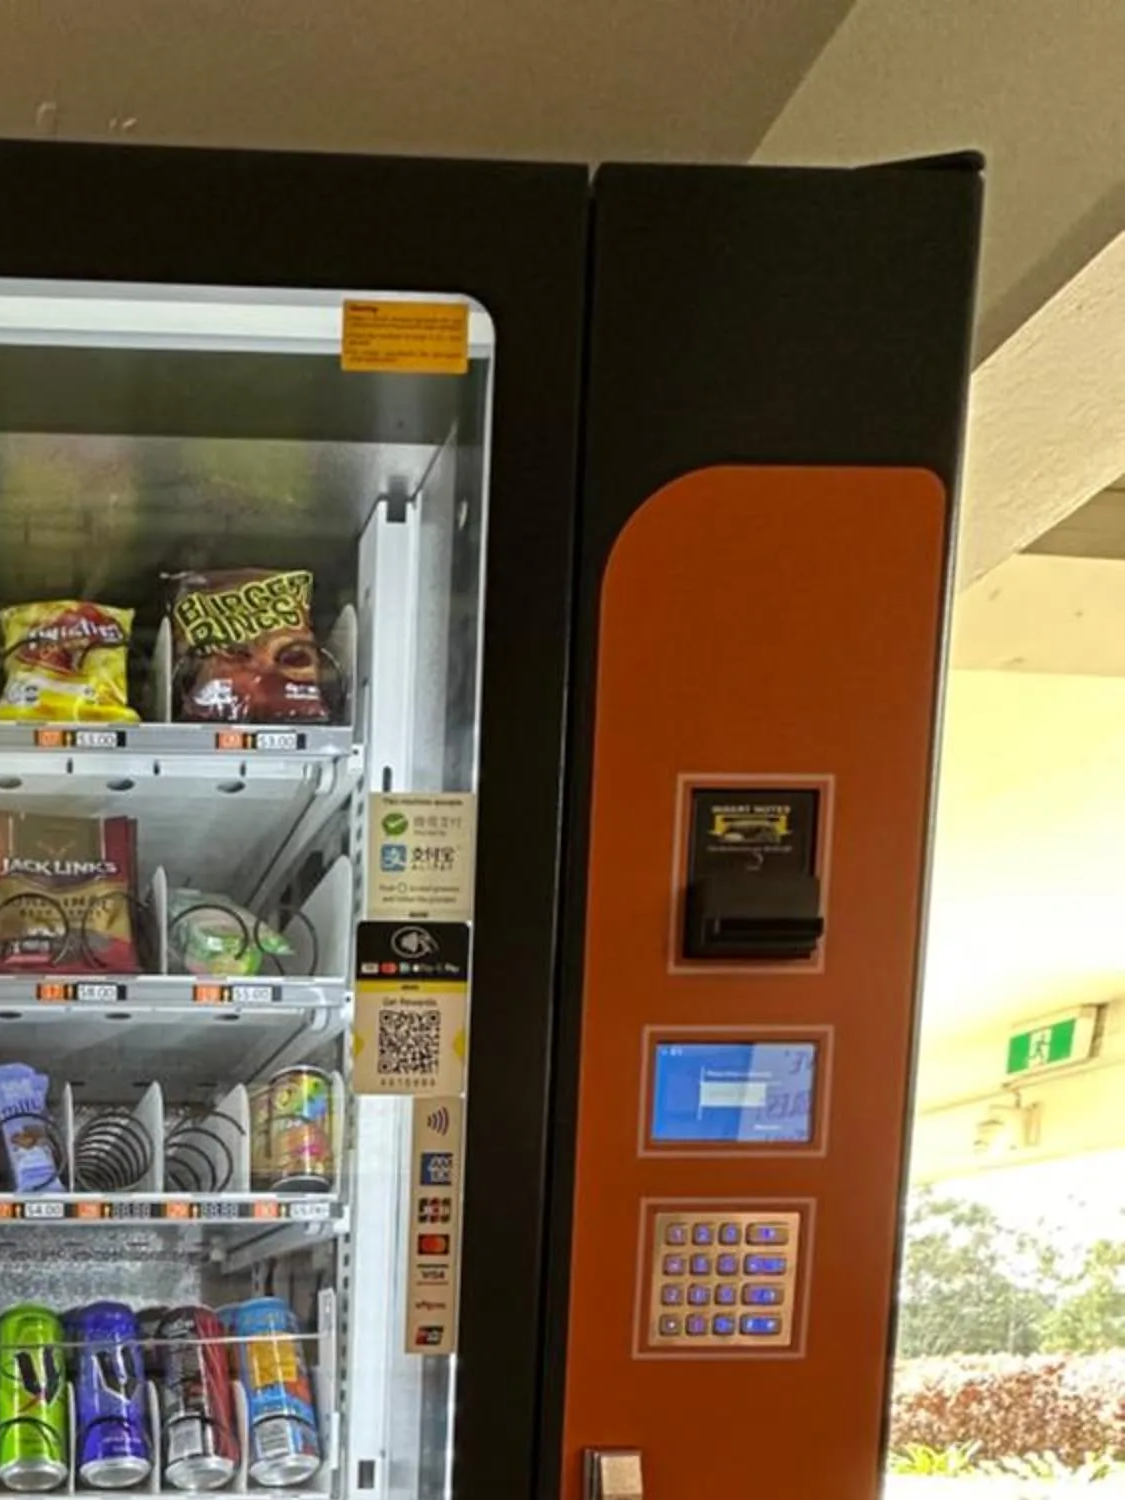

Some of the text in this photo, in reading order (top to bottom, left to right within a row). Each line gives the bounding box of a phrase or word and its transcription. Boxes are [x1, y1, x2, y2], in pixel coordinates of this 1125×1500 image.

[175, 570, 313, 630] BURGER
[185, 597, 303, 646] RINGS
[0, 857, 53, 876] JACK
